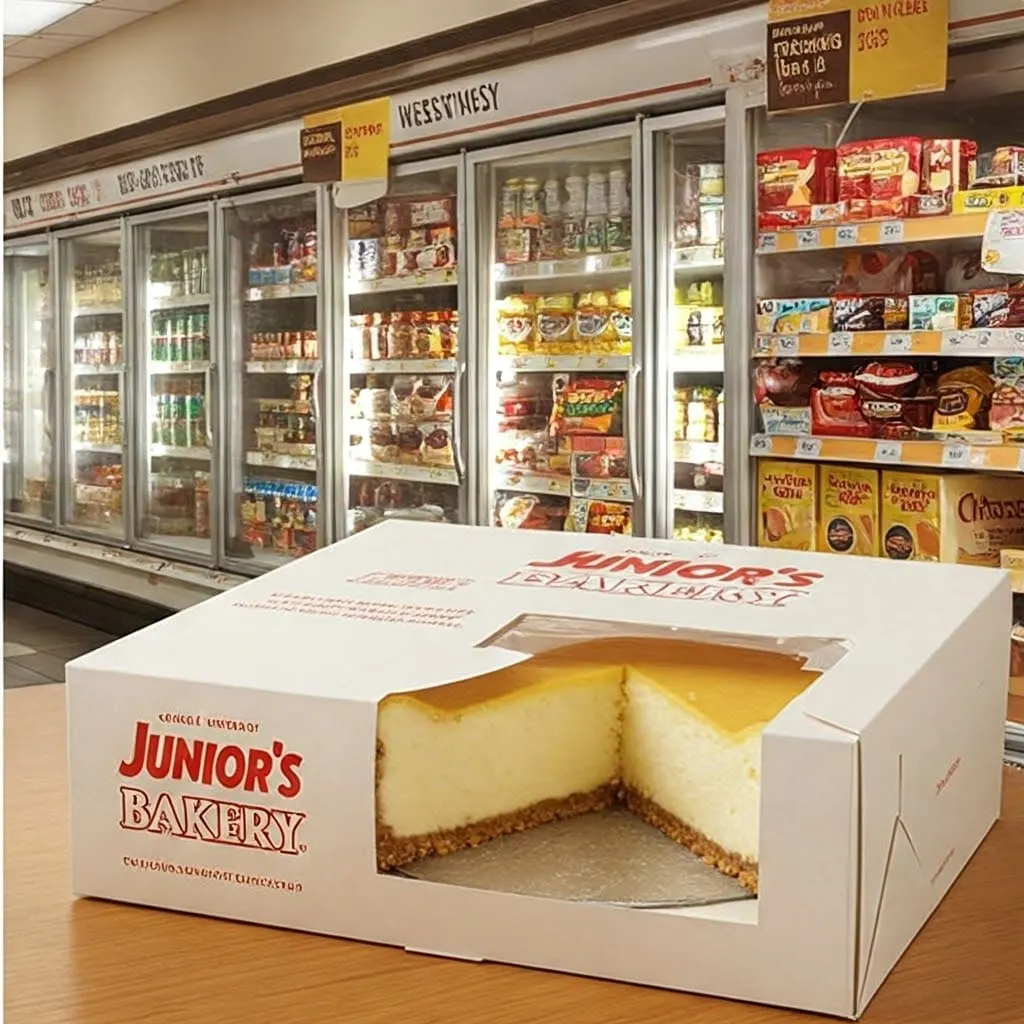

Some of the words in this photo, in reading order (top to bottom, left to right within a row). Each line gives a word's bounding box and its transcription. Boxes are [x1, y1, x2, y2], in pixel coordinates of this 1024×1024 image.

[528, 550, 824, 587] JUNIOR'S
[119, 721, 303, 798] JUNIOR'S
[120, 786, 306, 854] BAKERY
